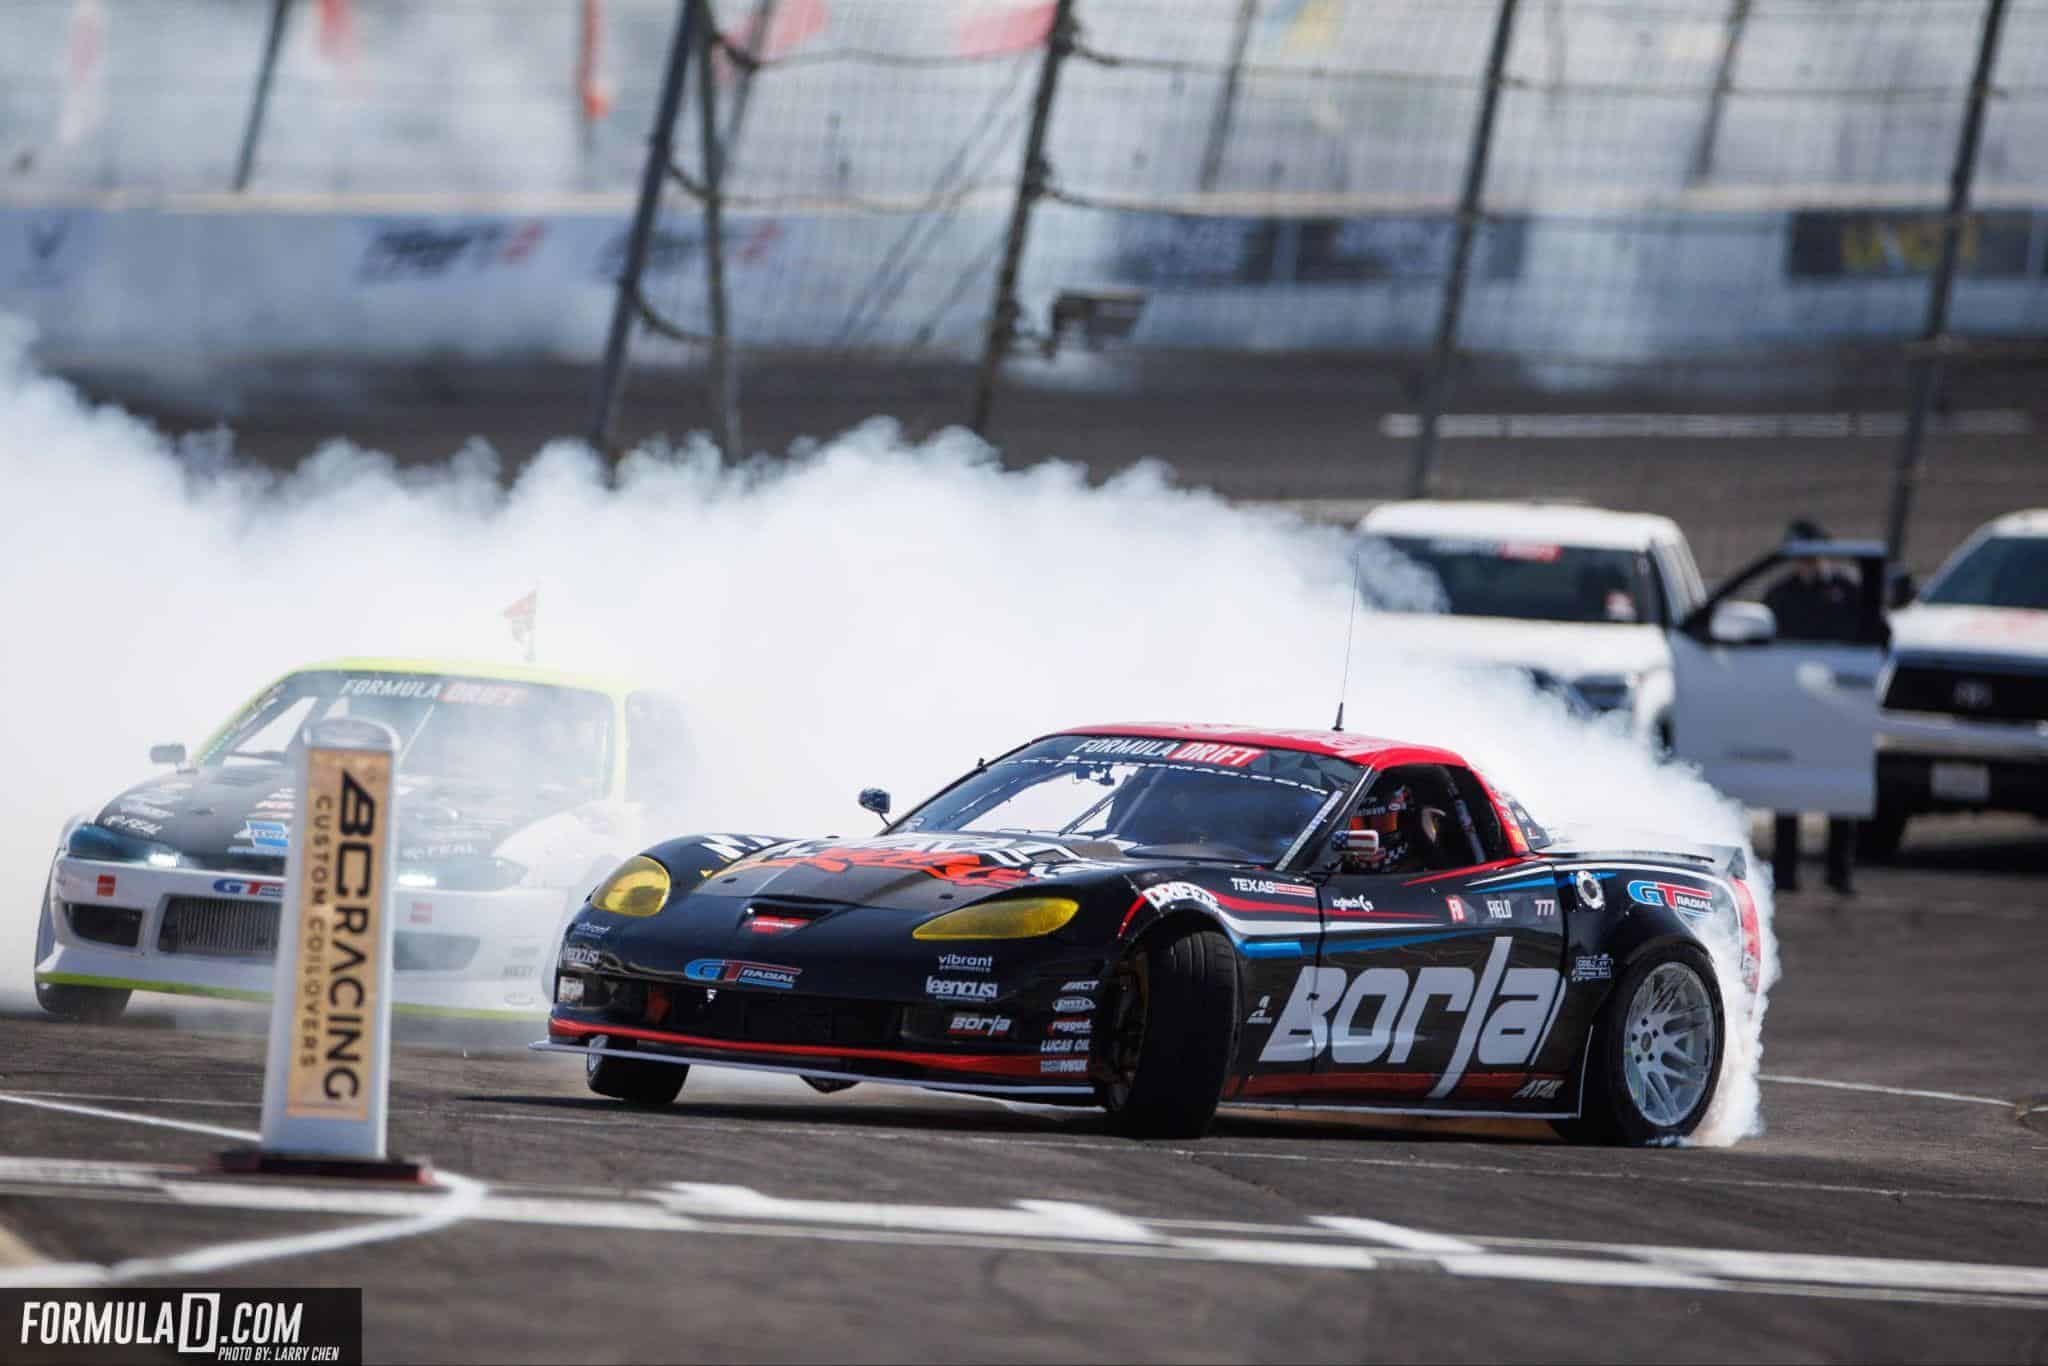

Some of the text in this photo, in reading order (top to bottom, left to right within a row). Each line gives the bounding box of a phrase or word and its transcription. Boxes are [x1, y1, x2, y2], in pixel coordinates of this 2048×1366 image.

[340, 679, 441, 698] FORMULA
[1072, 739, 1256, 765] FORMULA DRIFT
[1231, 877, 1277, 894] TEXAS
[1627, 879, 1692, 909] GT
[1487, 899, 1513, 919] FIELD
[1534, 898, 1556, 917] 777
[300, 795, 334, 1068] CUSTOM COILOVERS
[938, 954, 993, 967] vibrant
[741, 968, 796, 984] RADIAL
